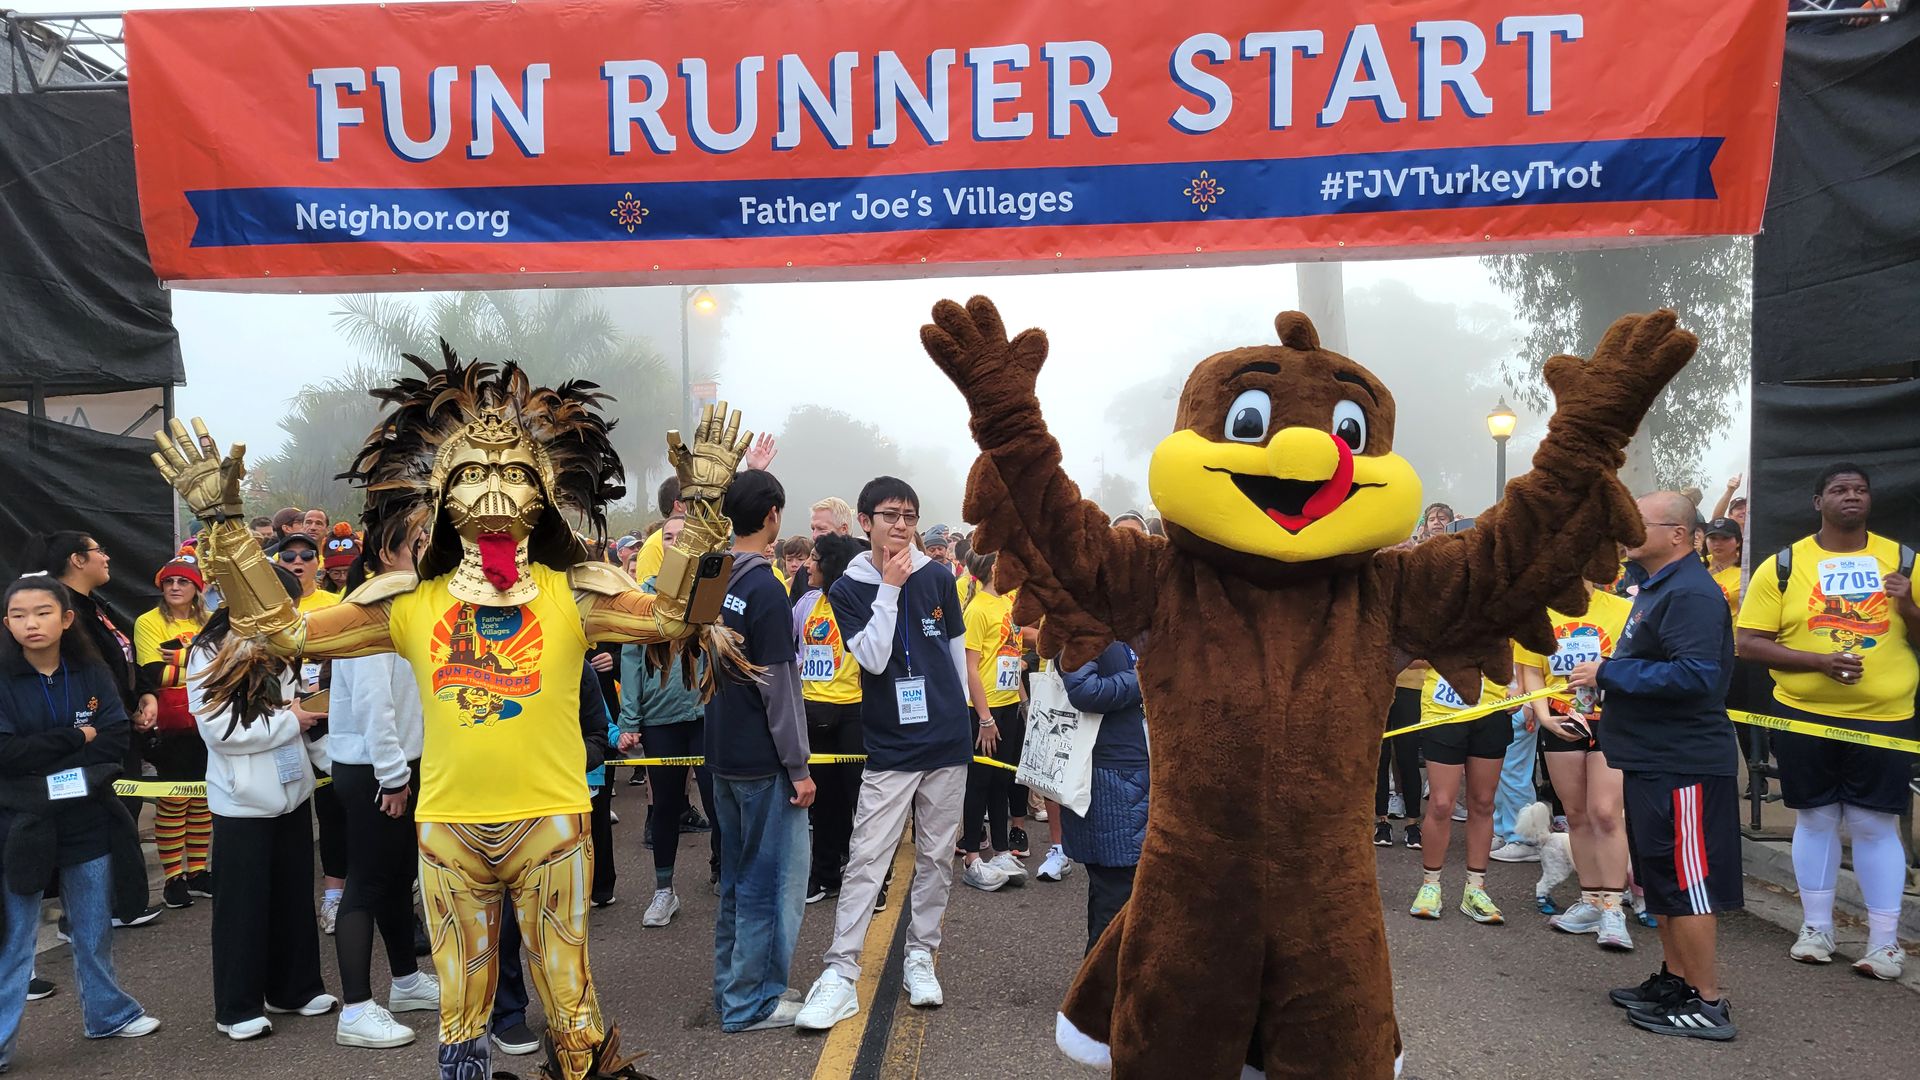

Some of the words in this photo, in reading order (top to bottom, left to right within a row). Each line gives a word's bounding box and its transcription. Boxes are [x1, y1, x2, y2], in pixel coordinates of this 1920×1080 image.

[308, 62, 551, 162] FUN
[601, 41, 1119, 156] RUNNER
[1168, 14, 1584, 135] START
[1319, 160, 1603, 202] #FJVTurkeyTrot
[739, 195, 842, 225] Father
[851, 188, 933, 219] Joe's
[943, 186, 1074, 222] Villages
[295, 202, 511, 238] Neighbor.org
[1823, 571, 1879, 591] 7705
[723, 594, 747, 615] EER
[481, 628, 511, 636] Villages
[438, 667, 462, 679] RUN
[466, 668, 491, 681] FOR
[495, 676, 531, 687] HOPE
[998, 670, 1021, 687] 476
[52, 772, 78, 781] RUN
[168, 784, 207, 796] CUIDAD
